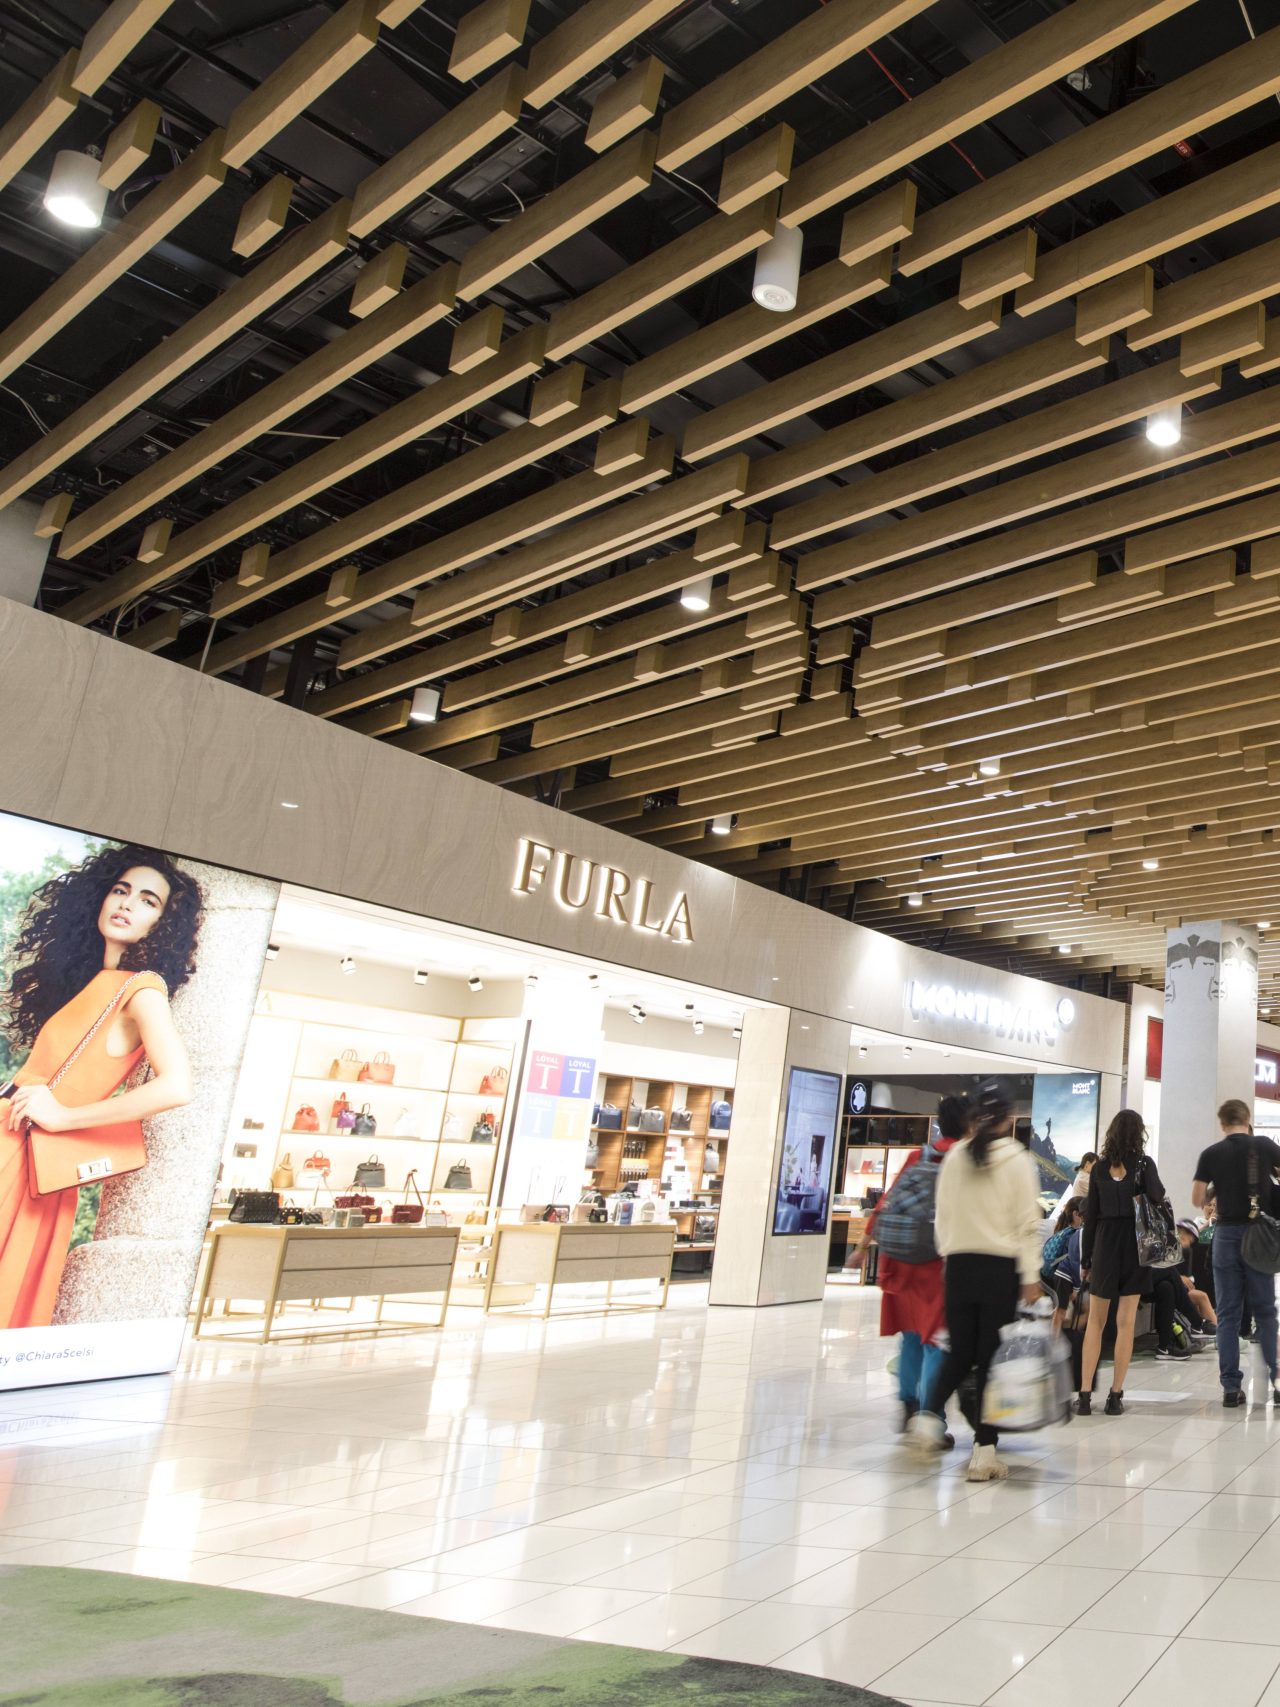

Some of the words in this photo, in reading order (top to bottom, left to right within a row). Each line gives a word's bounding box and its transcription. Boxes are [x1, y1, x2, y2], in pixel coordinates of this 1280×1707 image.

[511, 837, 695, 943] FURLA
[535, 1055, 560, 1065] LOYAL
[568, 1060, 592, 1069] LOYAL
[15, 1346, 95, 1363] @ChiaraScelsi
